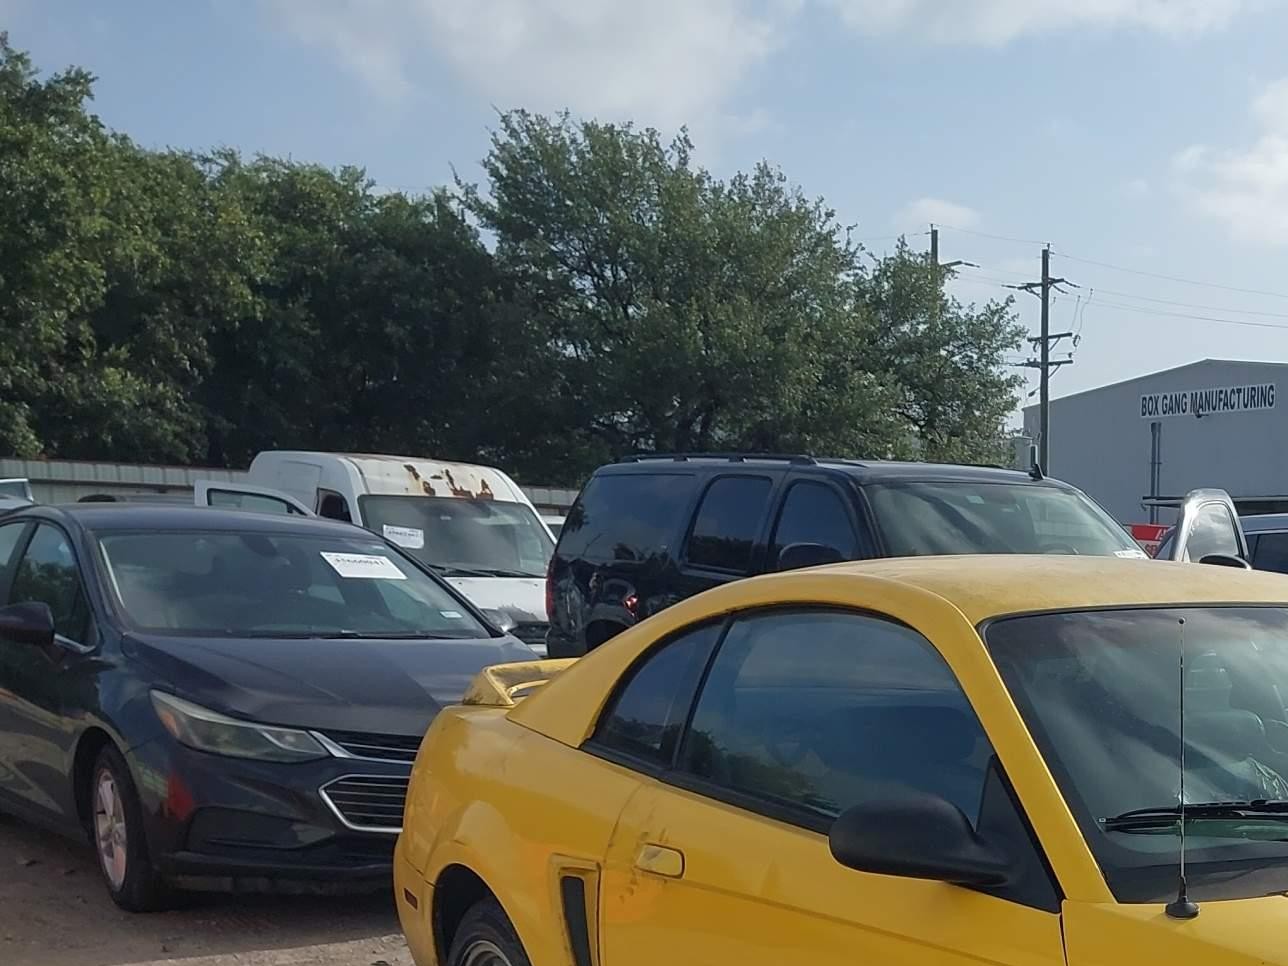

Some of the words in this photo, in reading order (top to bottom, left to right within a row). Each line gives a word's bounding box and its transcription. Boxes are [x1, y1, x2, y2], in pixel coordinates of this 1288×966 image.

[1141, 394, 1160, 417] BOX
[1161, 392, 1188, 416] GANG
[1189, 384, 1276, 414] MANUFACTURING
